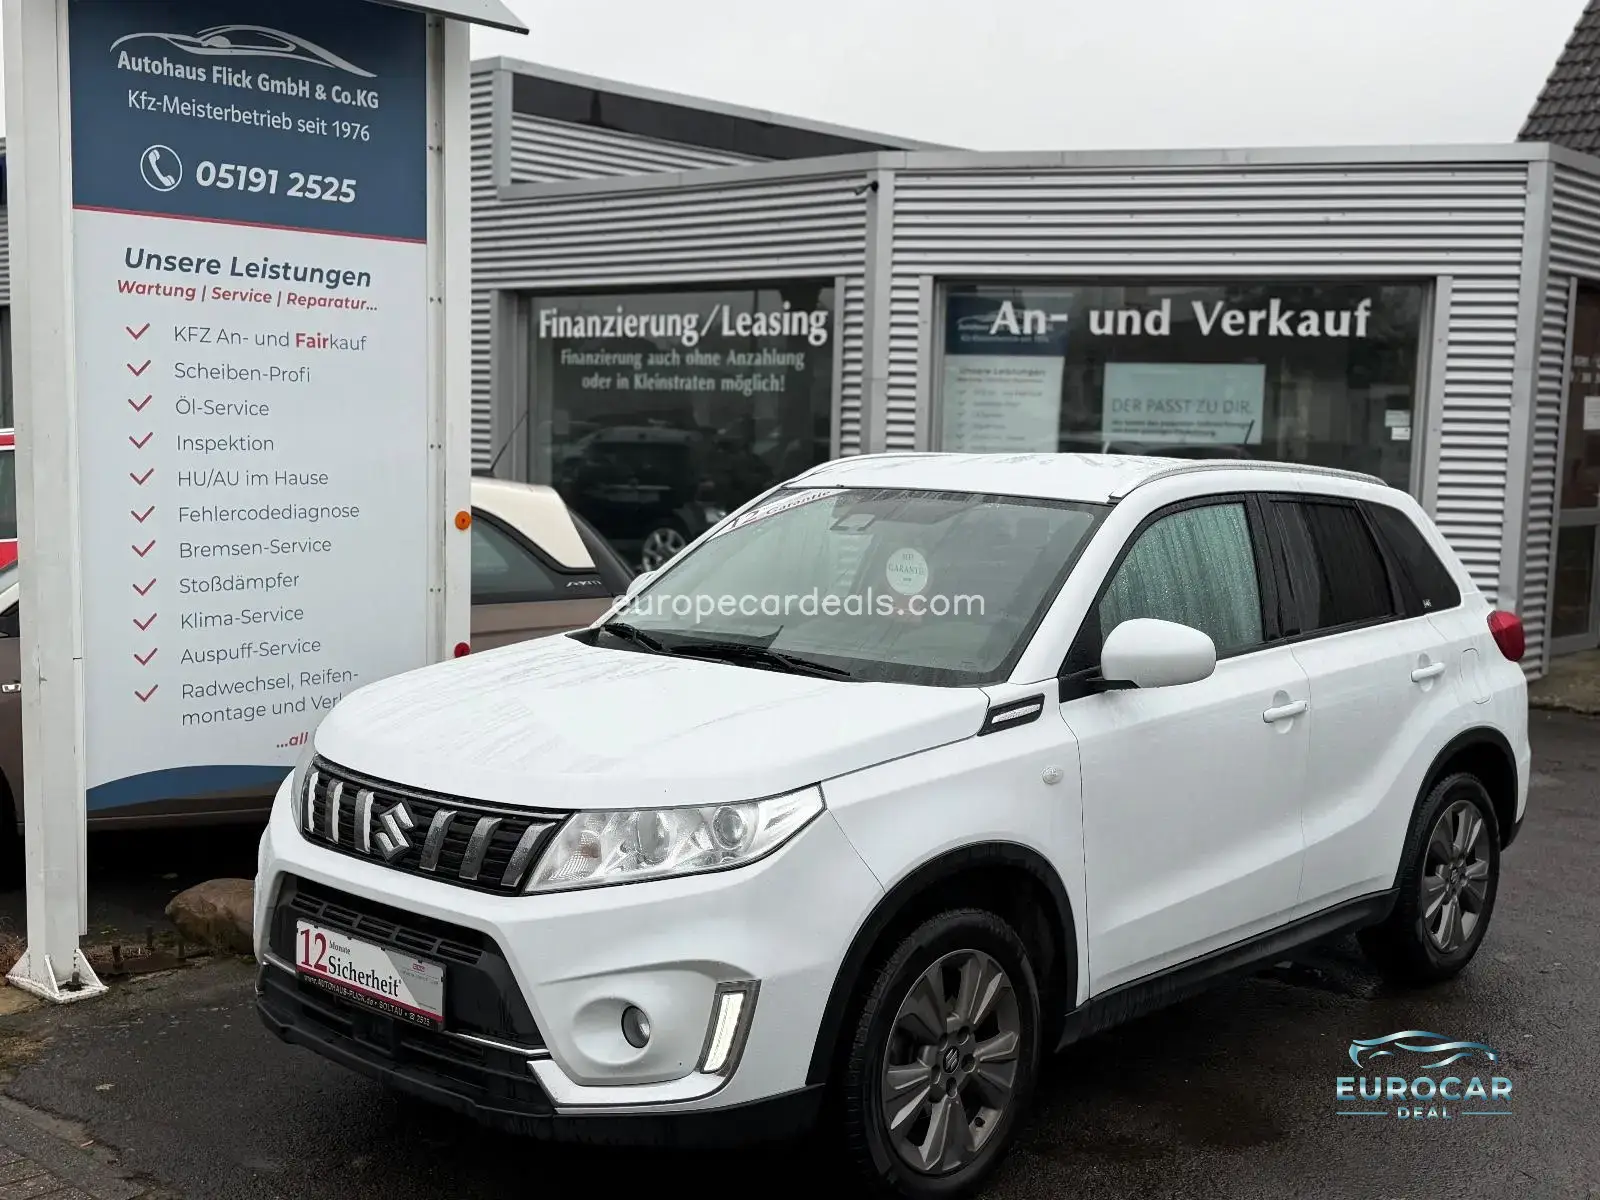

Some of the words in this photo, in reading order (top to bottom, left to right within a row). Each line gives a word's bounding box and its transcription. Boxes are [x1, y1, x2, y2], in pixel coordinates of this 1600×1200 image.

[118, 51, 206, 82] Autohaus
[212, 65, 252, 90] Flick
[257, 74, 310, 99] GmbH
[314, 84, 327, 101] &
[331, 86, 379, 109] Co.KG
[128, 90, 292, 130] Kfz-Meisterbetrieb
[298, 117, 328, 136] seit
[332, 120, 370, 142] 1976
[196, 160, 279, 194] 05191
[287, 172, 357, 204] 2525
[124, 248, 222, 275] Unsere
[231, 257, 372, 290] Leistungen
[117, 280, 196, 302] Wartung
[211, 287, 272, 304] Service
[287, 292, 378, 312] Reparatur...
[989, 300, 1068, 335] An-
[1089, 298, 1170, 337] und
[1191, 298, 1372, 338] Verkauf
[174, 326, 212, 344] KFZ
[216, 328, 248, 345] An-
[255, 330, 289, 347] und
[296, 332, 367, 352] Fairkauf
[561, 349, 642, 370] Finanzierung
[647, 350, 680, 366] auch
[686, 348, 721, 366] ohne
[726, 350, 806, 371] Anzahlung
[174, 362, 310, 383] Scheiben-Profi
[582, 374, 612, 390] oder
[616, 373, 630, 390] in
[634, 374, 715, 391] Kleinstraten
[720, 374, 786, 396] möglich!
[175, 396, 270, 416] Öl-Service
[1112, 398, 1142, 413] DER
[1146, 399, 1192, 414] PASST
[1196, 400, 1218, 414] ZU
[177, 434, 274, 454] Inspektion
[178, 468, 239, 487] HU/AU
[246, 469, 268, 486] im
[275, 470, 328, 486] Hause
[178, 504, 360, 523] Fehlercodediagnose
[180, 538, 332, 558] Bremsen-Service
[180, 573, 300, 594] Stoßdämpfer
[181, 606, 304, 630] Klima-Service
[181, 638, 321, 665] Auspuff-Service
[182, 672, 296, 700] Radwechsel,
[300, 666, 358, 688] Reifen-
[182, 704, 266, 726] montage
[272, 697, 306, 716] und
[300, 928, 328, 974] 12
[379, 1002, 402, 1016] SOLTAU
